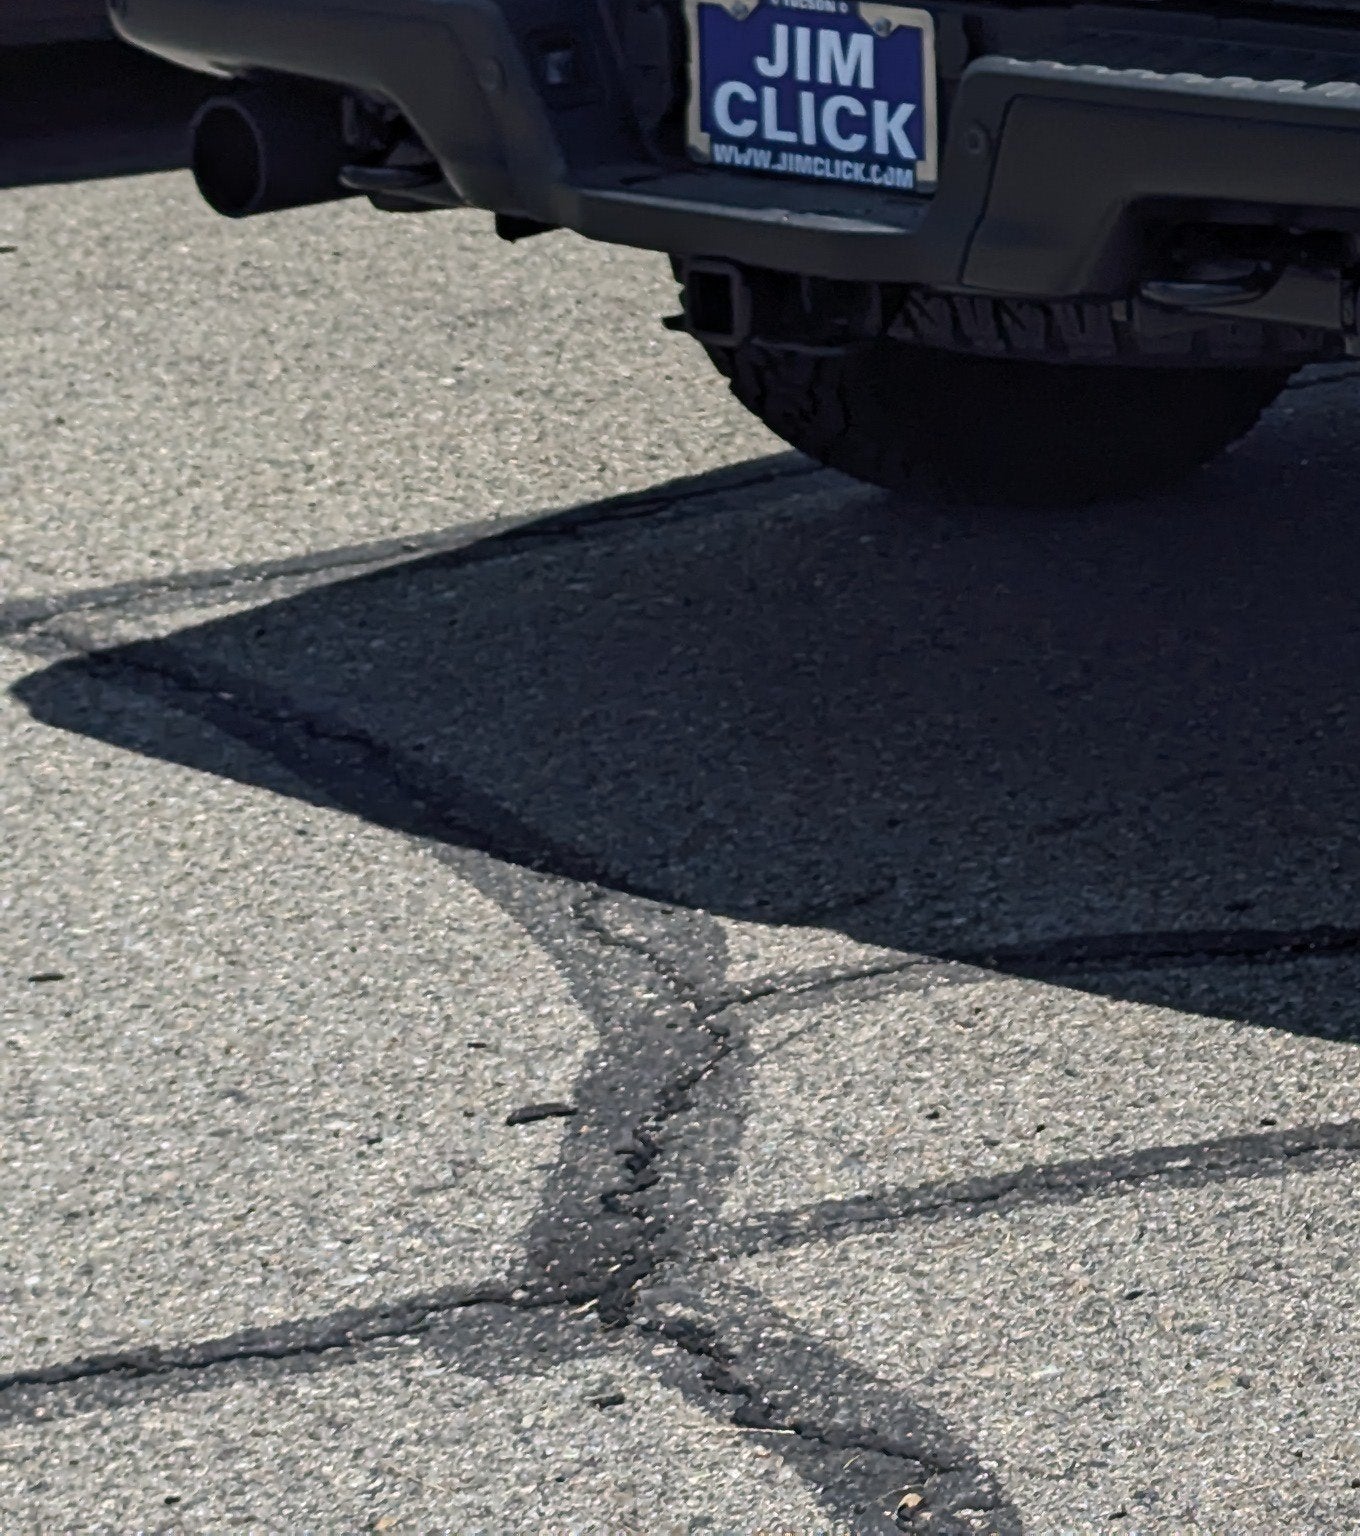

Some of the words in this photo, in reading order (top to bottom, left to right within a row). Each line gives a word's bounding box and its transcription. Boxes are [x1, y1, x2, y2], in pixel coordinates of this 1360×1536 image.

[754, 23, 874, 89] JIM
[713, 80, 917, 160] CLICK
[712, 142, 914, 189] WWW.JIMCLICK.COM
